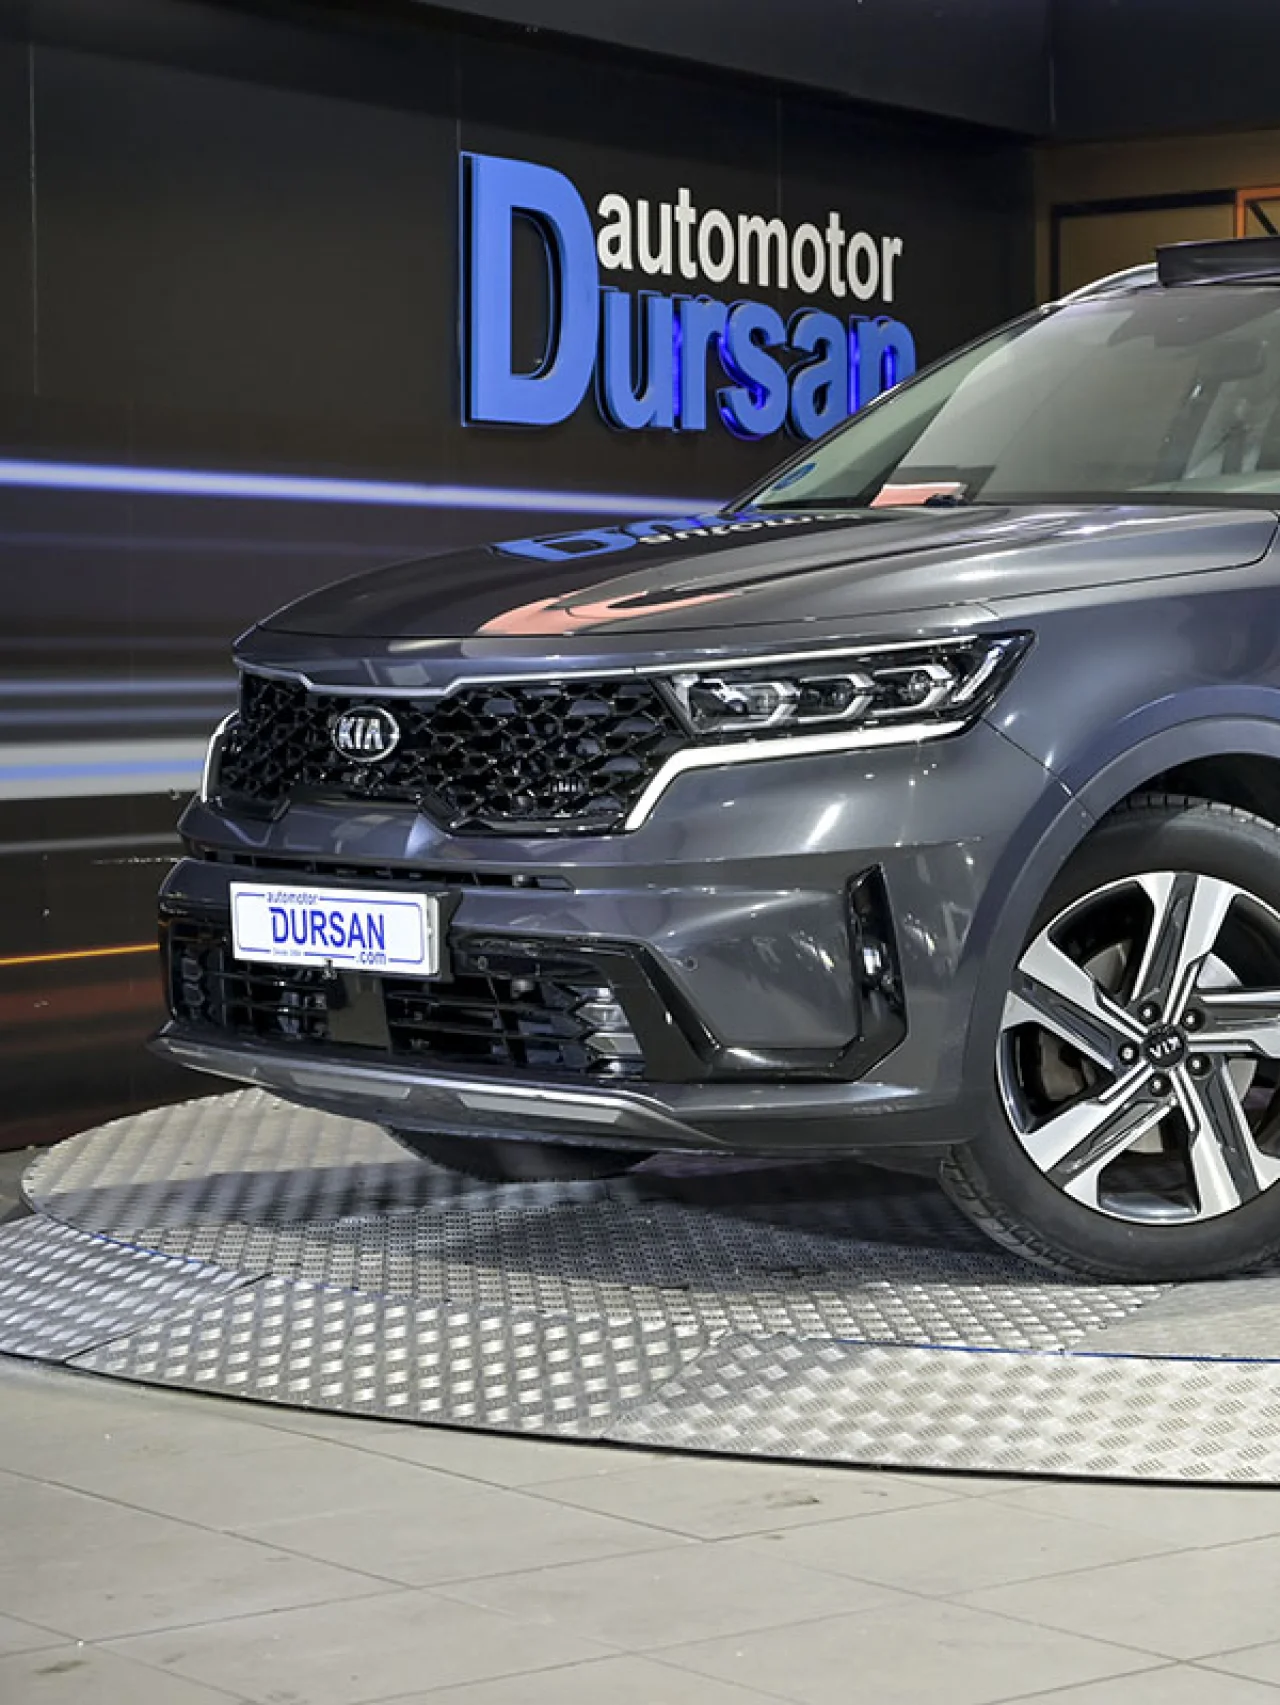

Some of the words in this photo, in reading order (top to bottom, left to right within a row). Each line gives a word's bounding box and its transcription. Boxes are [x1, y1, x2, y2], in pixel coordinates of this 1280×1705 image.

[598, 187, 903, 303] automotor
[460, 151, 917, 442] Dursan
[338, 717, 384, 751] KIA
[268, 906, 386, 951] DURSAN
